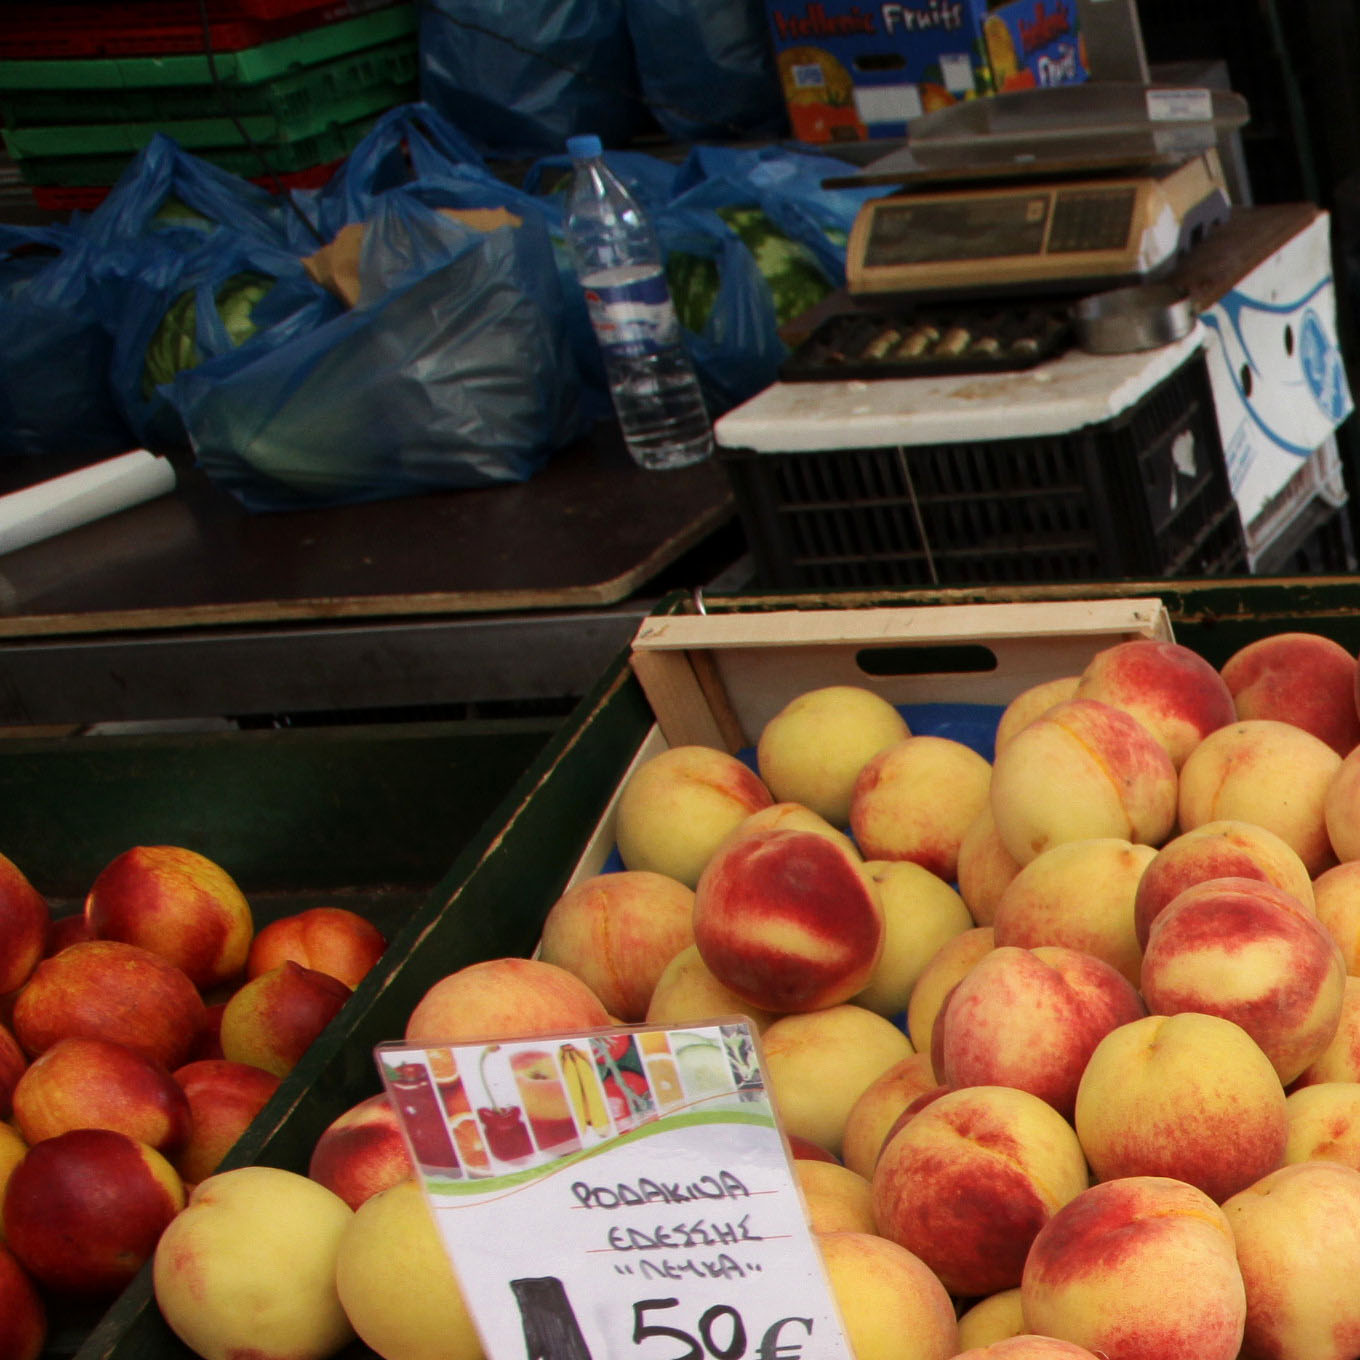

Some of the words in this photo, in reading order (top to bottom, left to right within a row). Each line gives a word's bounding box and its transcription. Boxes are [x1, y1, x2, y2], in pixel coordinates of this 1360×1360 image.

[881, 0, 962, 35] Fruits
[571, 1170, 750, 1209] ΡΟΔΑΚΙΝΑ
[608, 1214, 763, 1250] ΕΔΕΣΣΗΣ
